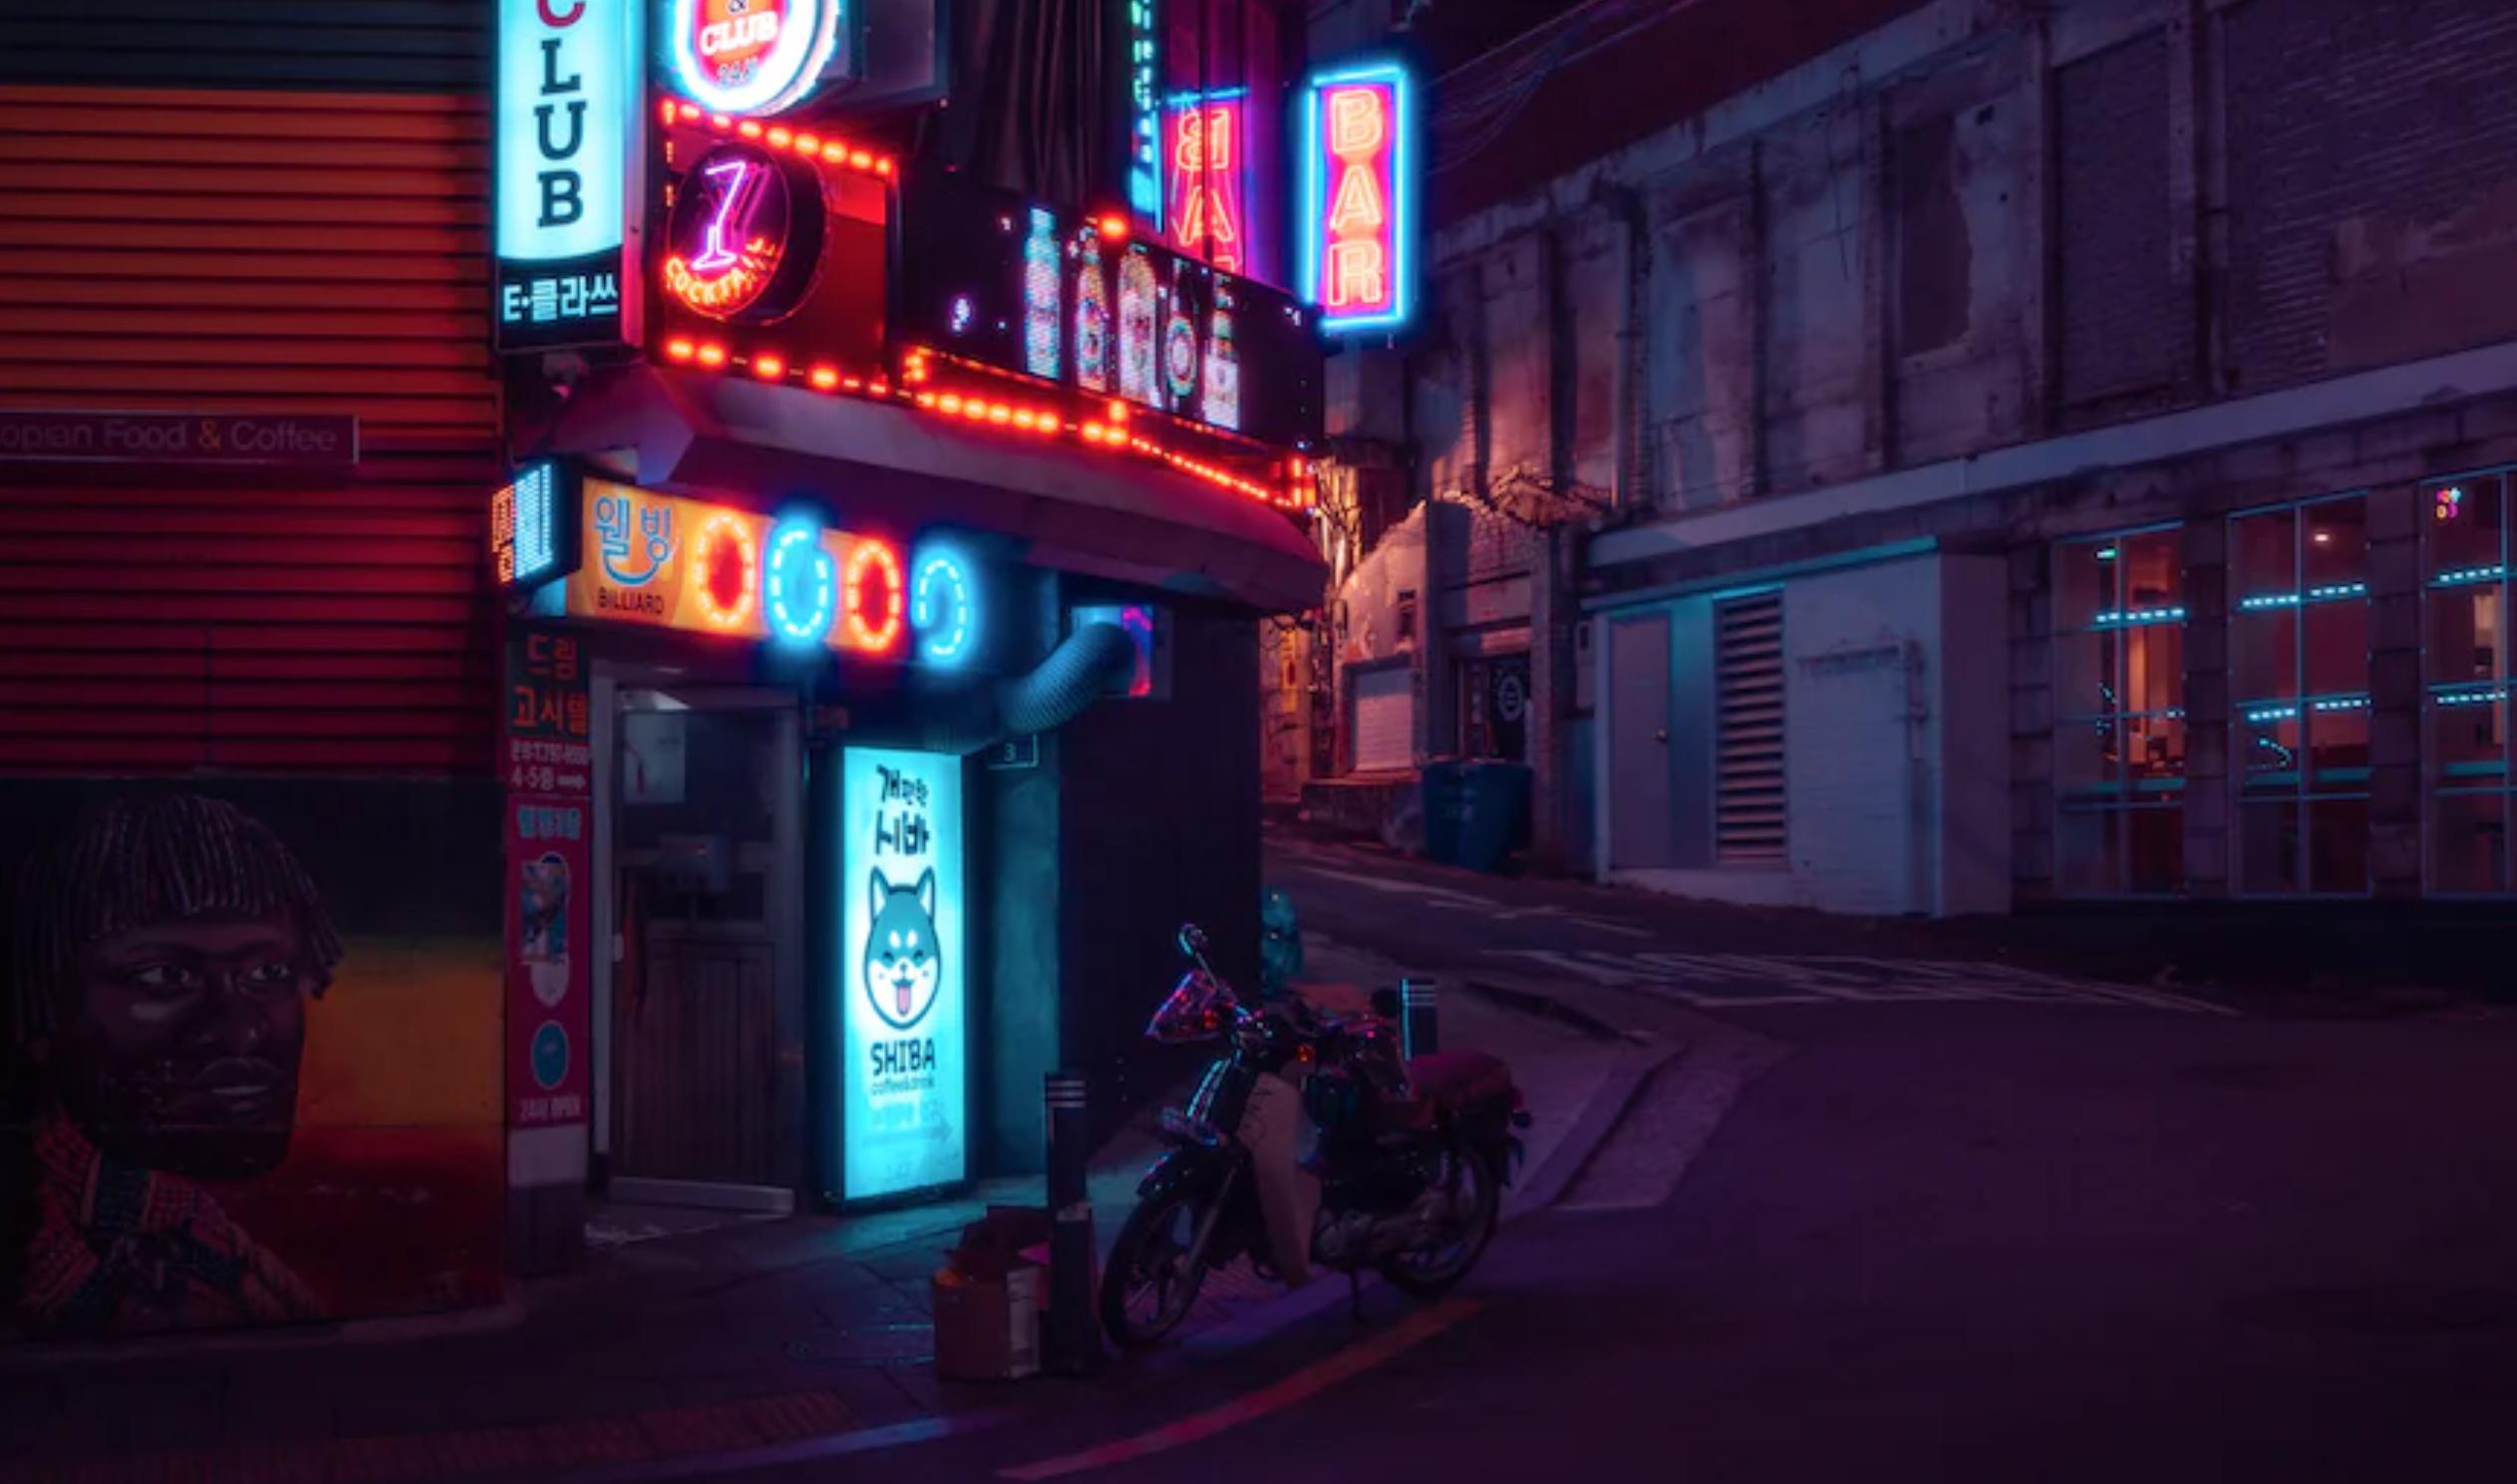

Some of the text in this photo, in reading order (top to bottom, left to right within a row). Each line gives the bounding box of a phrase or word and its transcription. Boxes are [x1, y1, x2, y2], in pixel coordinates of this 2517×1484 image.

[700, 11, 779, 56] CLUB
[1329, 89, 1383, 306] BAR
[103, 417, 187, 449] Food
[198, 419, 221, 450] &
[229, 419, 337, 451] Coffee
[599, 586, 666, 615] BILLIARD
[870, 1037, 936, 1076] SHIBA
